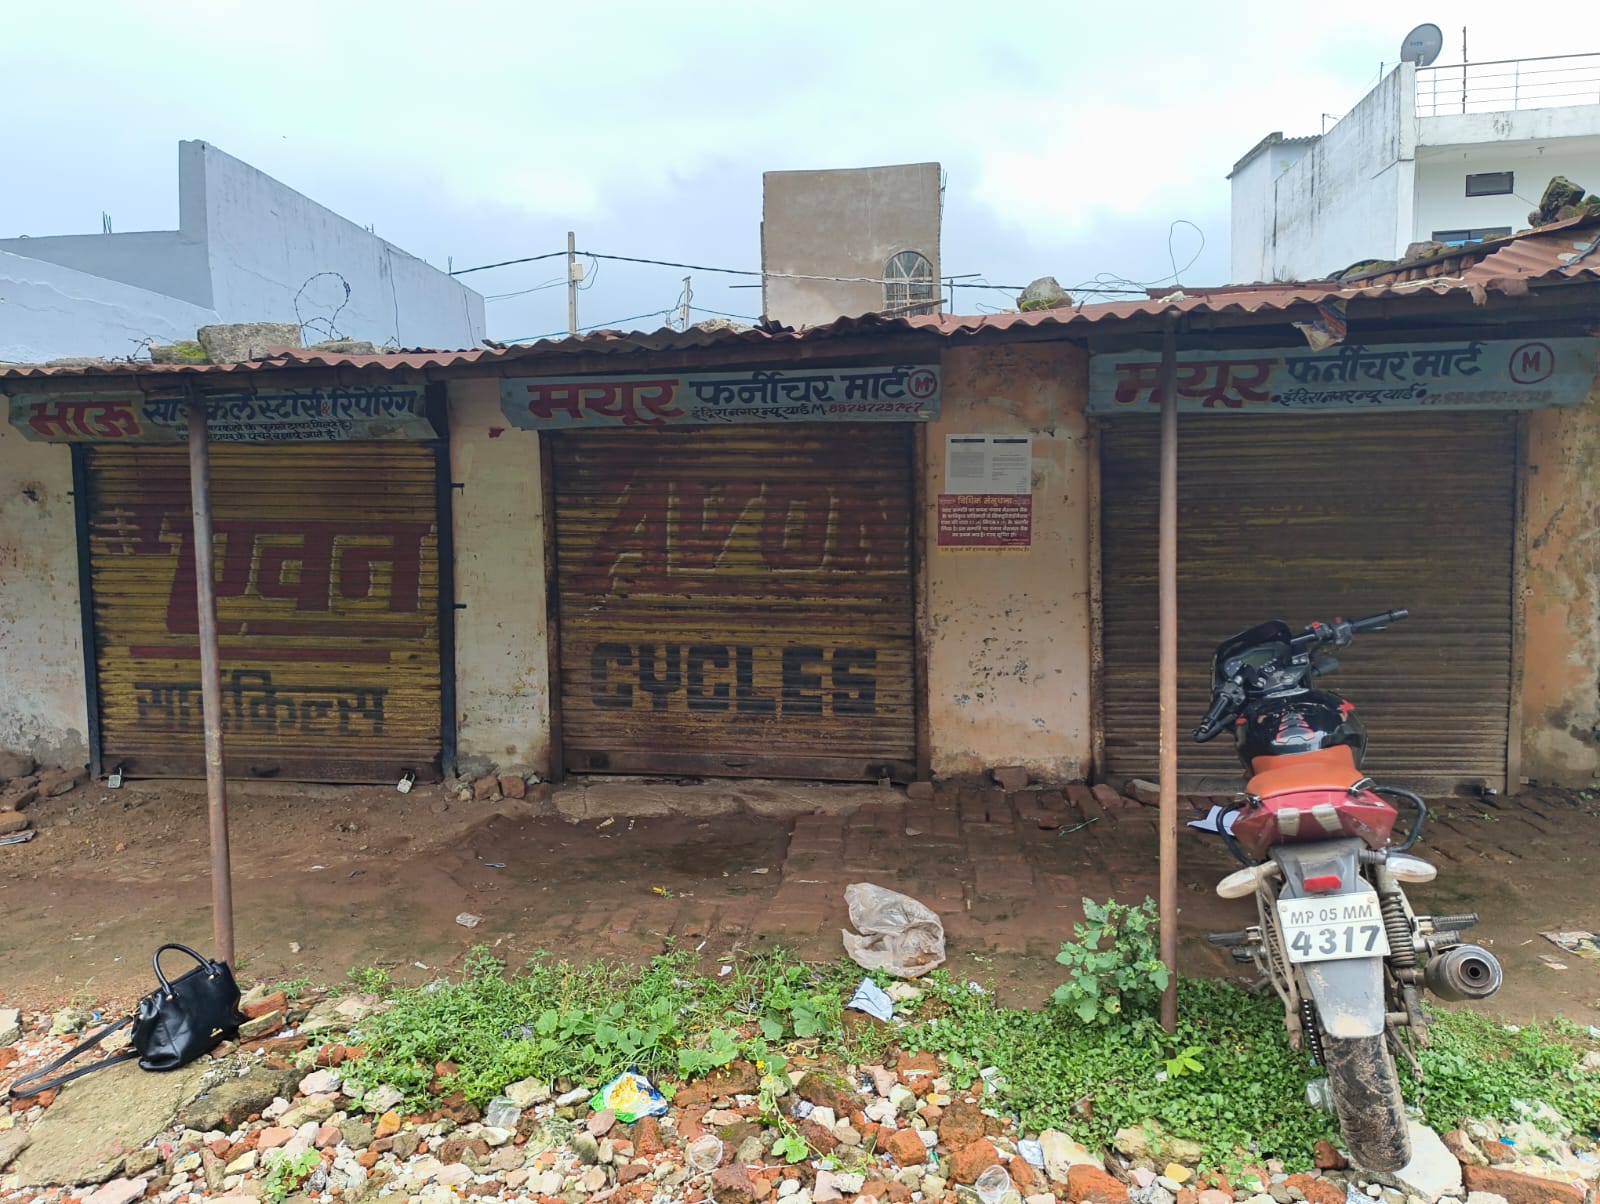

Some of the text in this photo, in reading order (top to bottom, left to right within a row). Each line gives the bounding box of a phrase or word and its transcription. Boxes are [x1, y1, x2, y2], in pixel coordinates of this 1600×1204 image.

[527, 379, 686, 425] मयूर
[688, 370, 835, 405] फर्नीचर
[839, 365, 914, 400] मार्ट
[1115, 357, 1280, 409] मयूर
[1284, 345, 1410, 384] फर्नीचर
[1411, 340, 1488, 377] मार्ट
[590, 642, 878, 716] CYCLES
[1290, 905, 1373, 925] MP 05 MM
[1291, 925, 1381, 956] 4317
